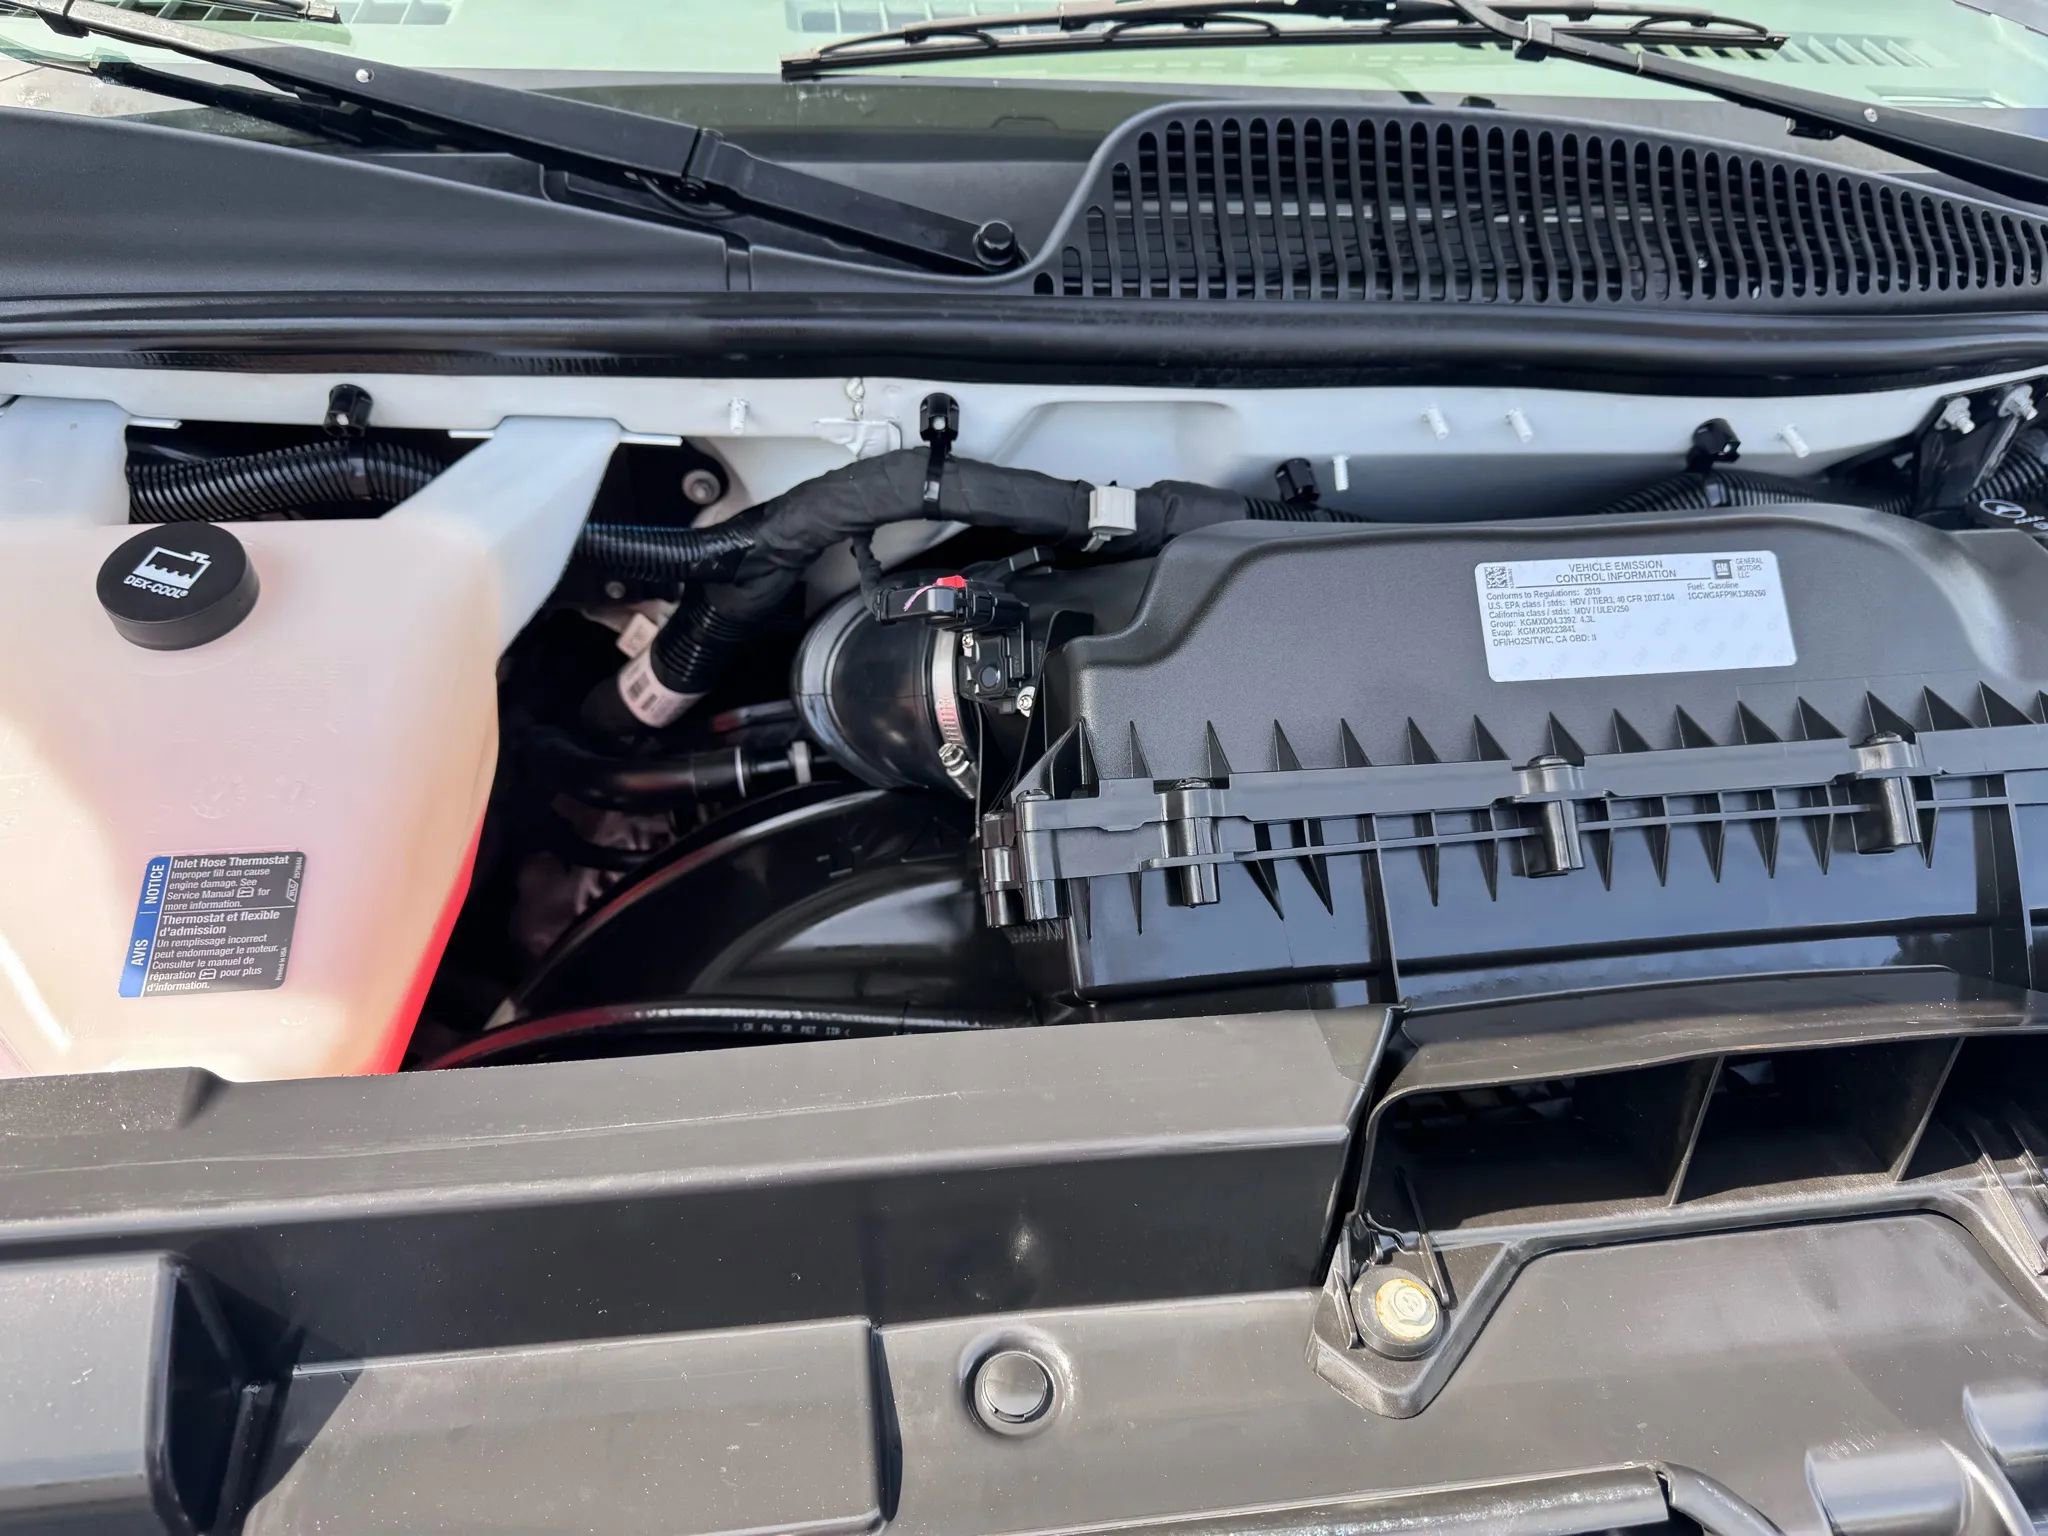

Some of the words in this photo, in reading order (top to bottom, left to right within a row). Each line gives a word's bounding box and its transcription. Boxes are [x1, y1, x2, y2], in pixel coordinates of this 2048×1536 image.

[1568, 561, 1612, 573] VEHICLE
[1614, 560, 1663, 570] EMISSION
[1556, 572, 1606, 584] CONTROL
[1607, 570, 1676, 581] INFORMATION
[1687, 582, 1704, 590] Fuel:
[1708, 581, 1739, 590] Gasoline
[1486, 592, 1522, 600] Conforms
[1534, 589, 1580, 600] Regulations:
[1584, 588, 1600, 596] 2019
[1488, 601, 1503, 610] U.S.
[1504, 600, 1520, 609] EPA
[1522, 600, 1542, 608] class
[1547, 599, 1566, 607] stds:
[1626, 594, 1642, 603] CFR
[1644, 594, 1674, 602] 1037.104
[1489, 610, 1524, 618] California
[1552, 608, 1570, 616] stds:
[1574, 606, 1591, 615] MDV
[1596, 605, 1630, 614] ULEV250
[1490, 620, 1516, 628] Group:
[1492, 629, 1512, 638] Evap:
[1556, 635, 1568, 644] CA
[1569, 634, 1590, 642] OBD:
[174, 858, 198, 869] Inlet
[200, 857, 226, 868] Hose
[230, 855, 289, 866] Thermostat
[171, 870, 210, 880] Improper
[213, 869, 224, 878] fill
[244, 868, 270, 876] cause
[144, 864, 164, 904] NOTICE
[169, 880, 198, 890] engine
[201, 879, 238, 889] damage.
[240, 878, 258, 886] See
[167, 891, 200, 900] Service
[202, 889, 234, 898] Manual
[258, 888, 271, 896] for
[164, 903, 188, 911] more
[190, 900, 242, 910] information.
[162, 913, 225, 925] Thermostat
[226, 913, 238, 922] et
[240, 910, 280, 921] flexible
[160, 925, 226, 937] d'admission
[157, 939, 170, 948] Un
[171, 936, 226, 947] remplissage
[228, 934, 267, 944] incorrect
[131, 939, 148, 966] AVIS
[154, 951, 174, 960] peut
[176, 948, 234, 958] endommager
[246, 946, 279, 954] moteur.
[152, 960, 196, 970] Consulter
[197, 959, 205, 967] le
[207, 957, 241, 966] manuel
[243, 956, 255, 965] de
[275, 964, 284, 981] Printed
[280, 947, 288, 957] USA
[150, 971, 196, 981] réparation
[242, 967, 262, 976] plus
[146, 981, 210, 992] d'information.
